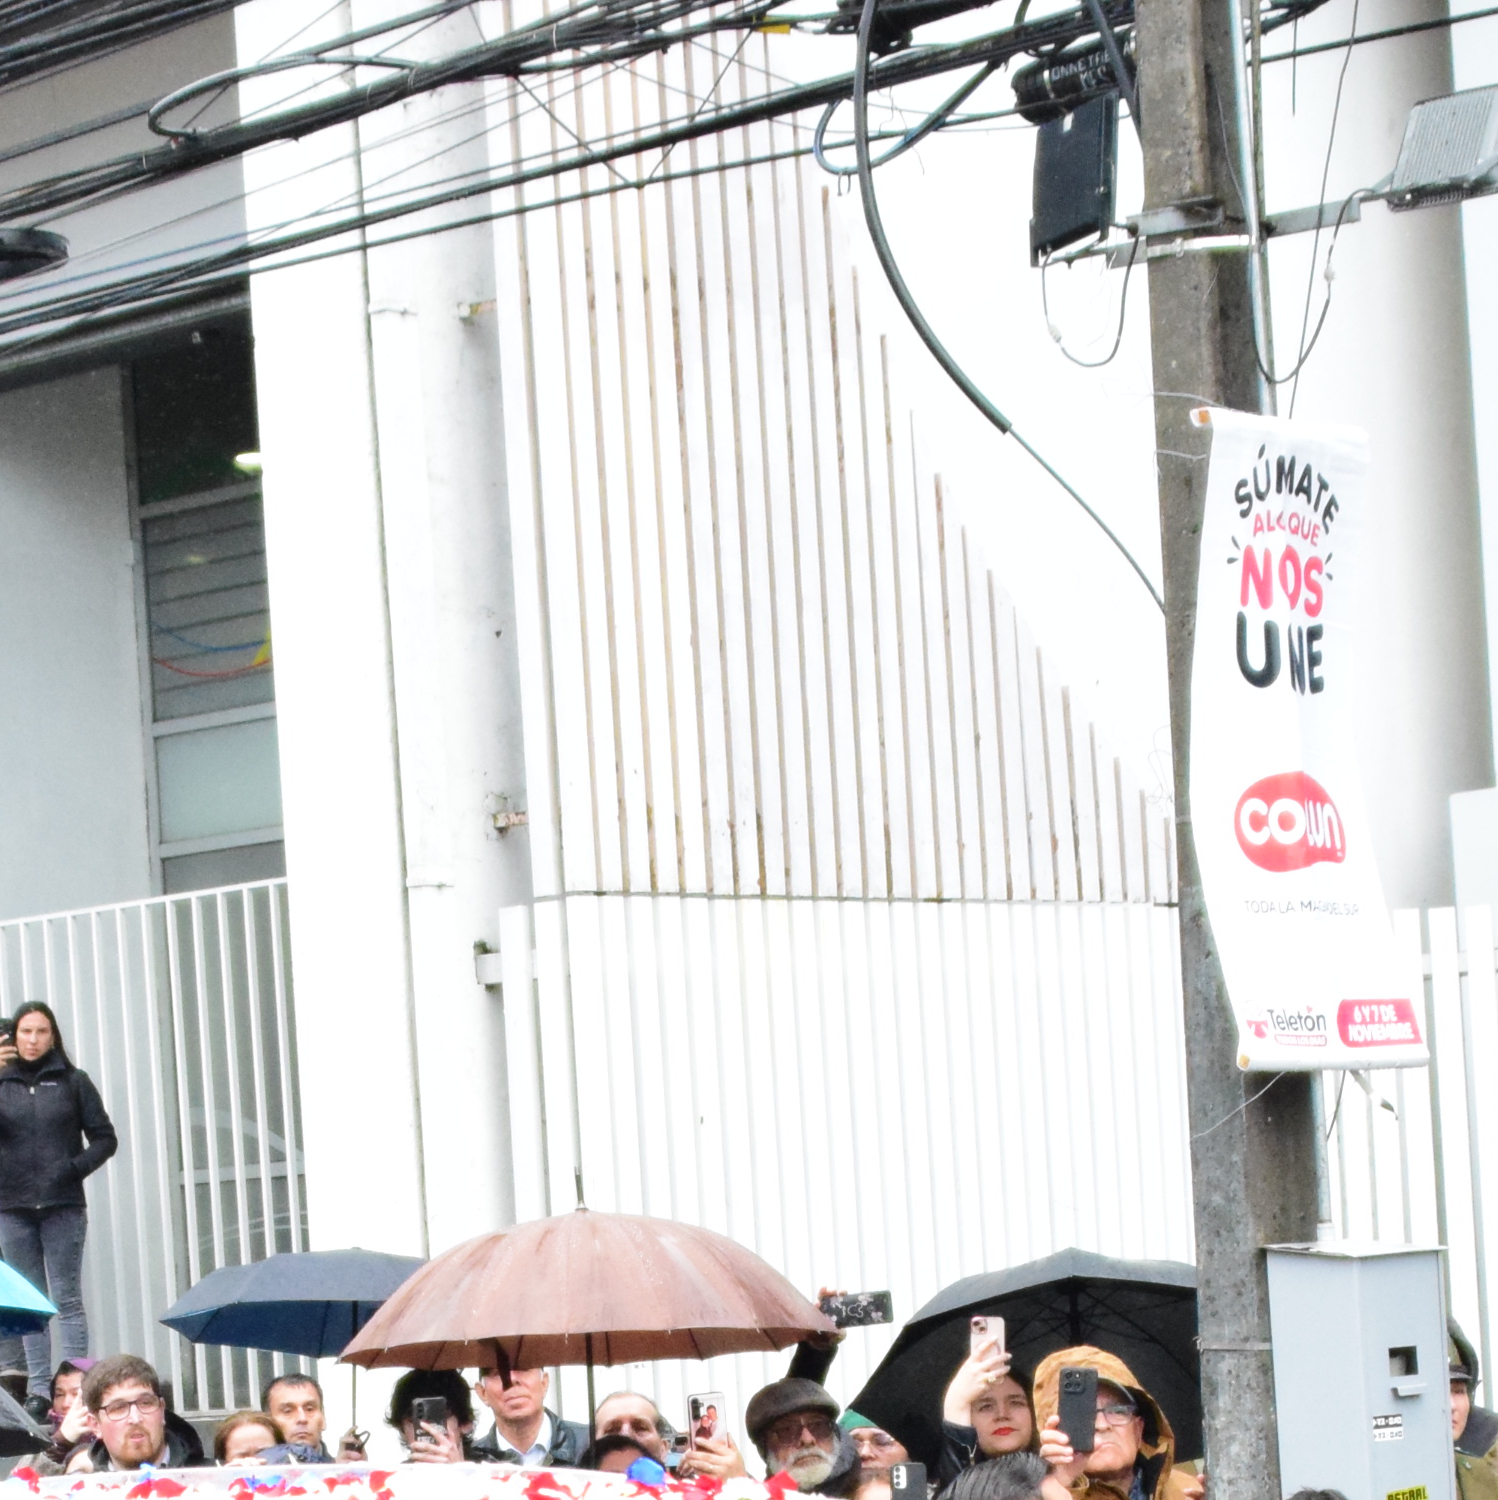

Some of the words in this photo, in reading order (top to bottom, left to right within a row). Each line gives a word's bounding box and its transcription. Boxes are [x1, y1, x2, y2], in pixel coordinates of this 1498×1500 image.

[1234, 443, 1339, 535] SÚMATE
[1288, 511, 1321, 547] QUE
[1239, 544, 1324, 618] NOS
[1236, 610, 1325, 696] UNE
[1348, 1022, 1415, 1042] NOVIEMBRE
[1379, 1004, 1398, 1022] DE
